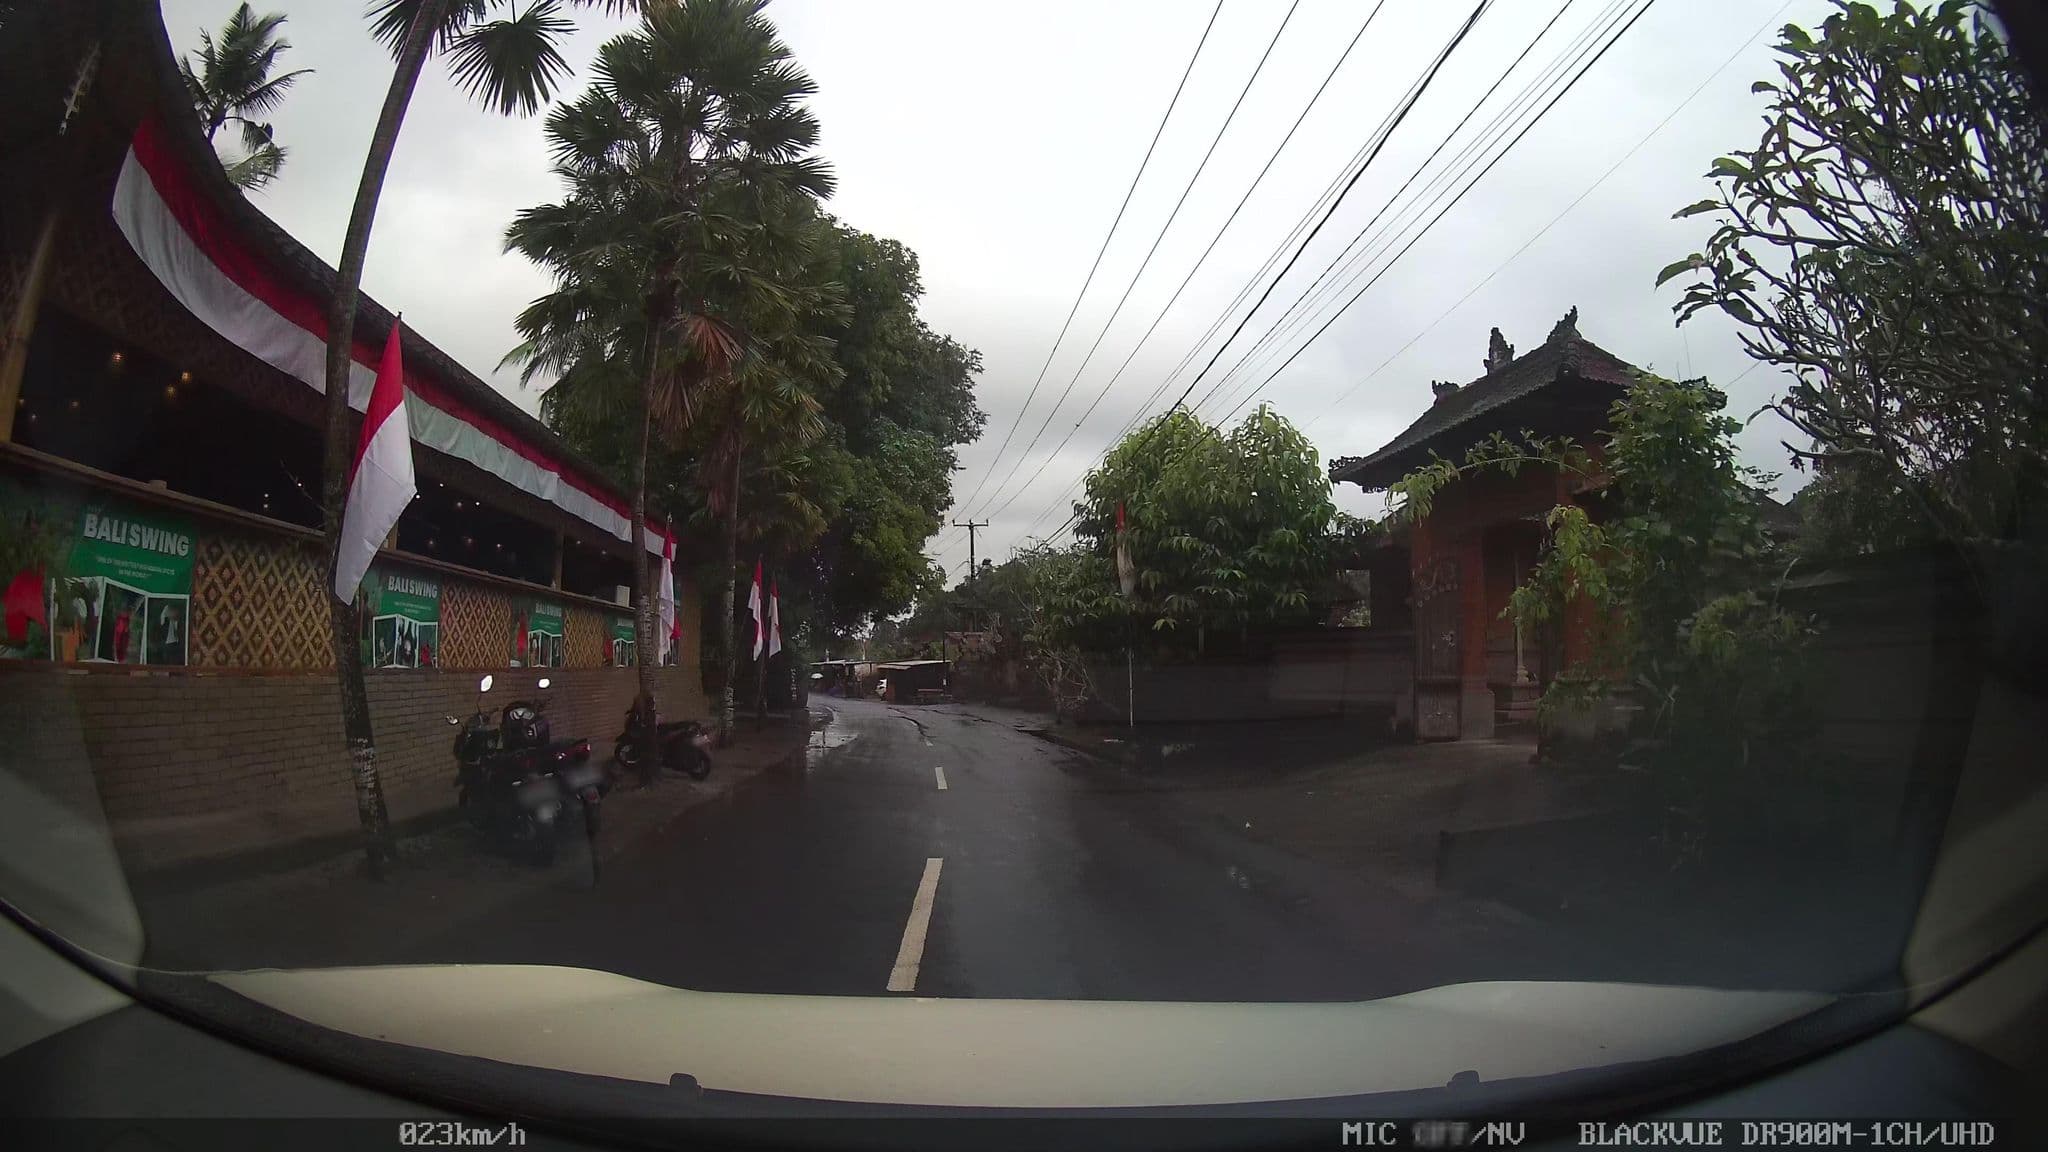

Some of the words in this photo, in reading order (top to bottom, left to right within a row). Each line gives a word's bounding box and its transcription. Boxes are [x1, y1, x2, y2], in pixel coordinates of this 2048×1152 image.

[83, 513, 128, 545] BALI
[129, 523, 190, 557] SWING
[388, 575, 409, 593] BALI
[409, 579, 438, 599] SWING
